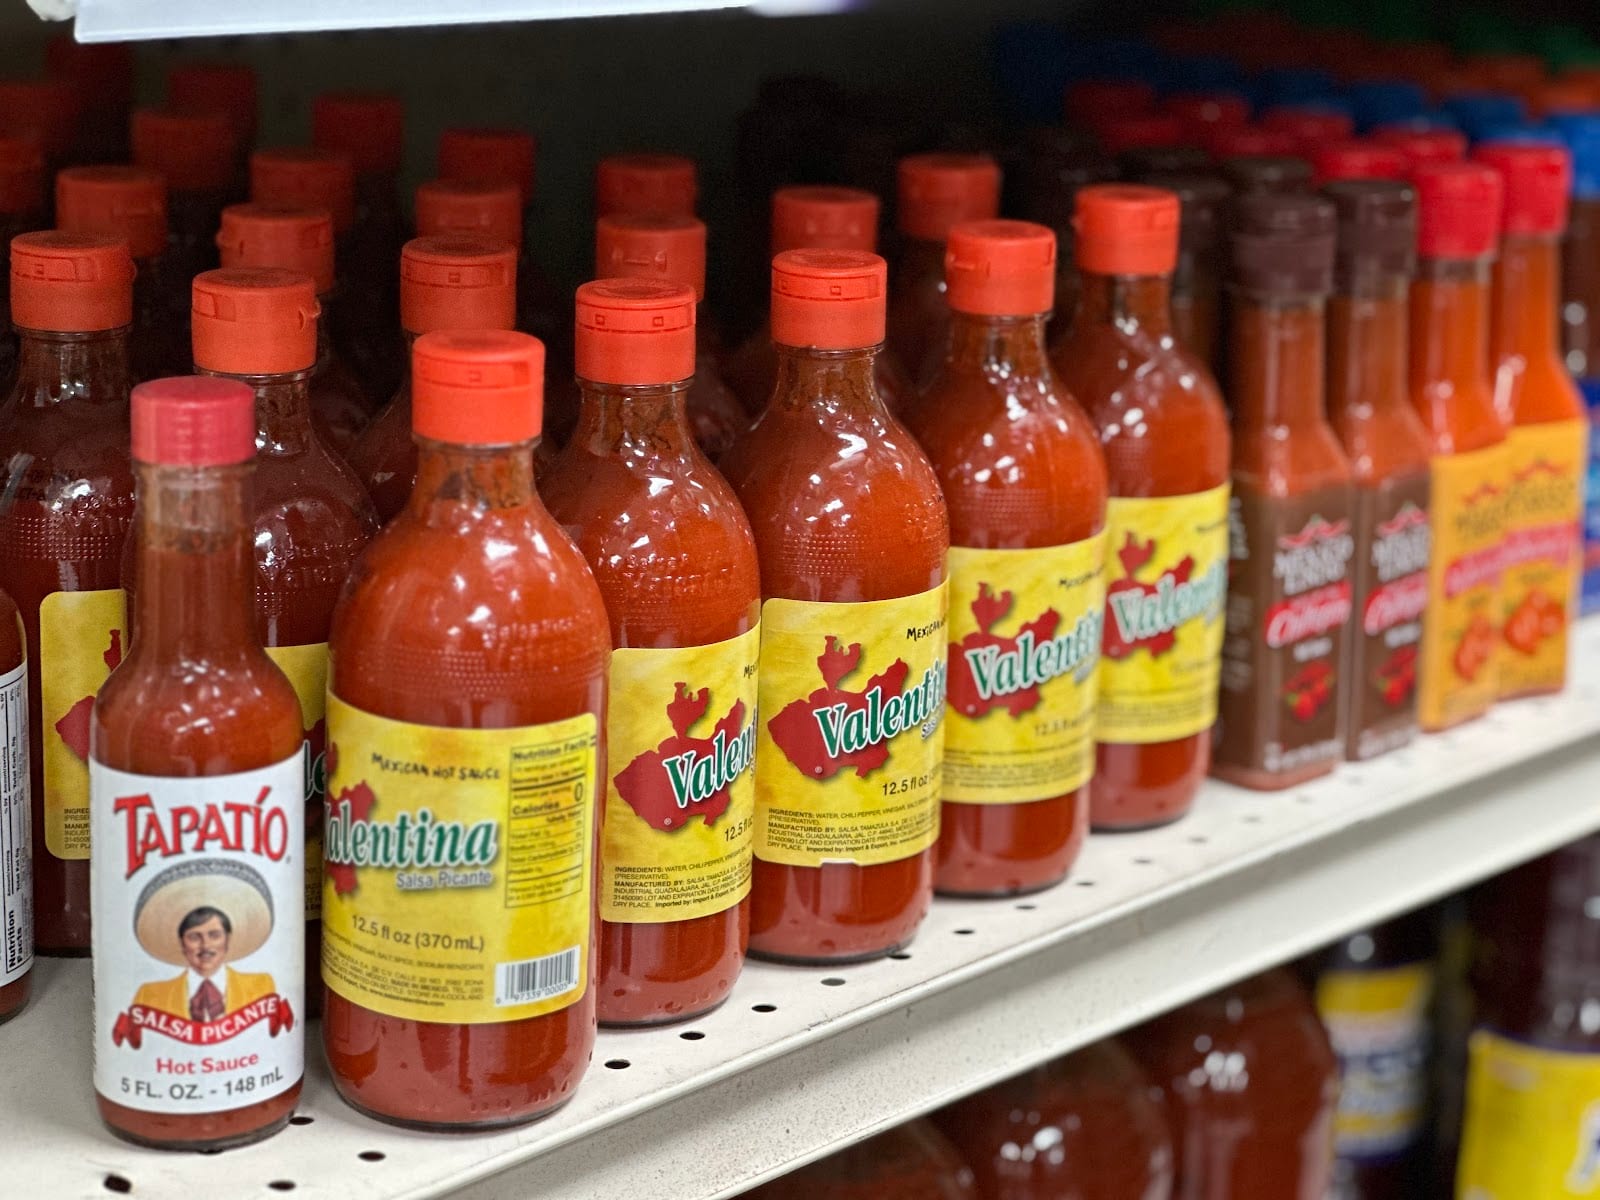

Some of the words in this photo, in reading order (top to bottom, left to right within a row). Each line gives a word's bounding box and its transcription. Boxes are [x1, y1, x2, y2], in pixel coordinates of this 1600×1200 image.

[371, 752, 429, 777] MEXICAN
[433, 766, 456, 779] HOT
[458, 767, 500, 780] SAUCE
[882, 779, 908, 796] 12.5
[910, 776, 917, 790] fl
[512, 800, 559, 816] Calories
[574, 781, 583, 802] 0
[768, 807, 815, 819] INGREDIENTS:
[113, 785, 288, 880] TAPATÍO
[725, 821, 743, 842] 12.5
[768, 822, 823, 833] MANUFACTURED
[768, 829, 804, 839] INDUSTRIAL
[396, 871, 434, 889] Salsa
[438, 870, 491, 886] Picante
[614, 887, 653, 895] INDUSTRIAL
[655, 901, 682, 909] Imported
[8, 909, 16, 968] Nutrition
[352, 914, 378, 936] 12.5
[382, 925, 390, 940] fl
[393, 931, 411, 945] oz
[131, 1005, 193, 1042] SALSA
[200, 996, 278, 1043] PICANTE
[156, 1057, 195, 1074] Hot
[201, 1053, 258, 1074] Sauce
[121, 1077, 131, 1094] 5
[135, 1081, 163, 1099] FL.
[169, 1084, 204, 1100] OZ.
[225, 1077, 256, 1096] 148
[260, 1066, 284, 1087] mL
